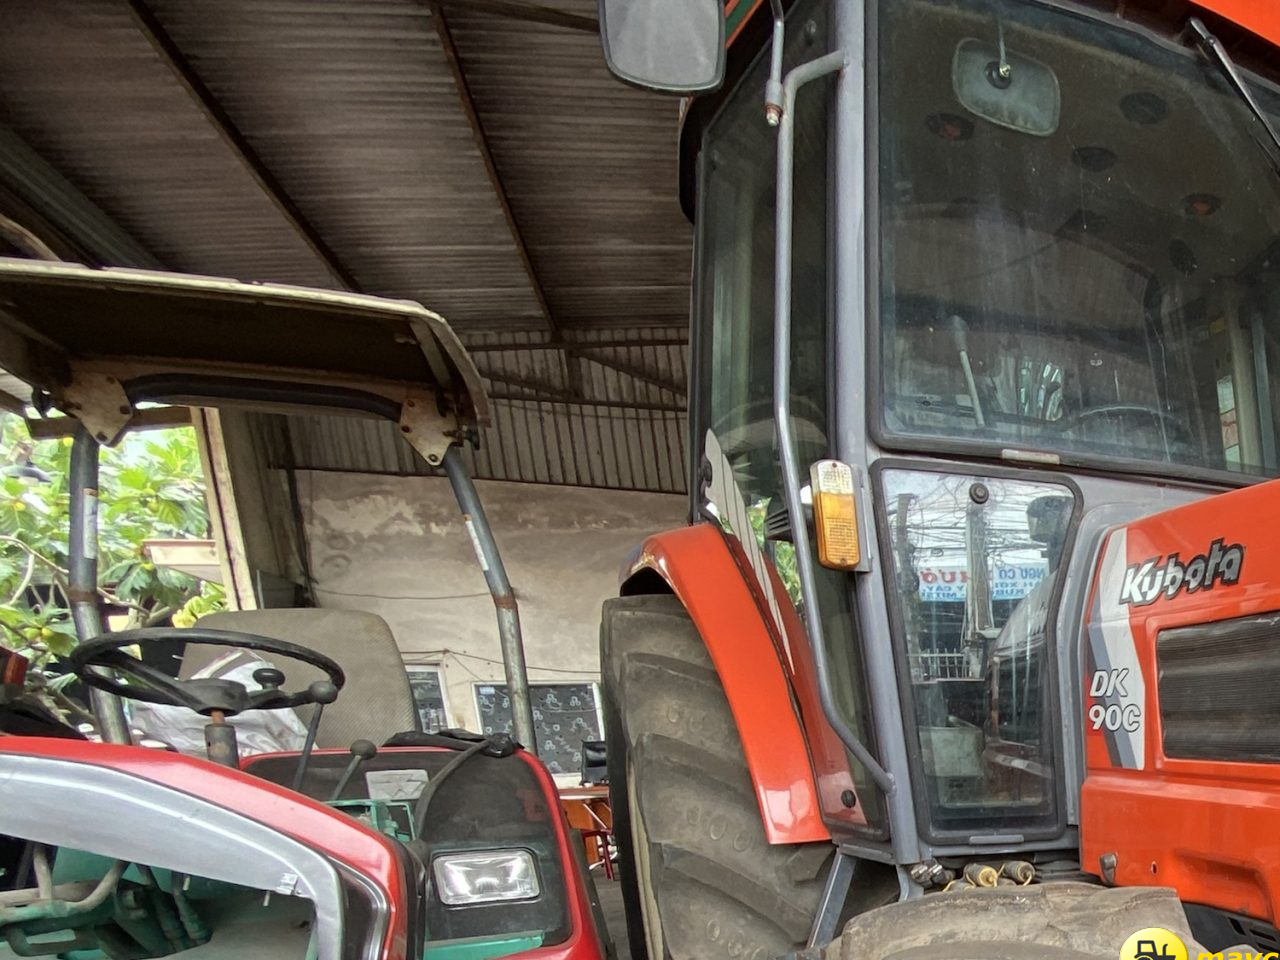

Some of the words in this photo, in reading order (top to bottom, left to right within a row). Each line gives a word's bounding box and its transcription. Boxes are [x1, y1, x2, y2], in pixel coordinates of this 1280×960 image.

[1119, 538, 1246, 605] Kubota
[1089, 667, 1130, 699] DK
[1087, 703, 1142, 734] 90C
